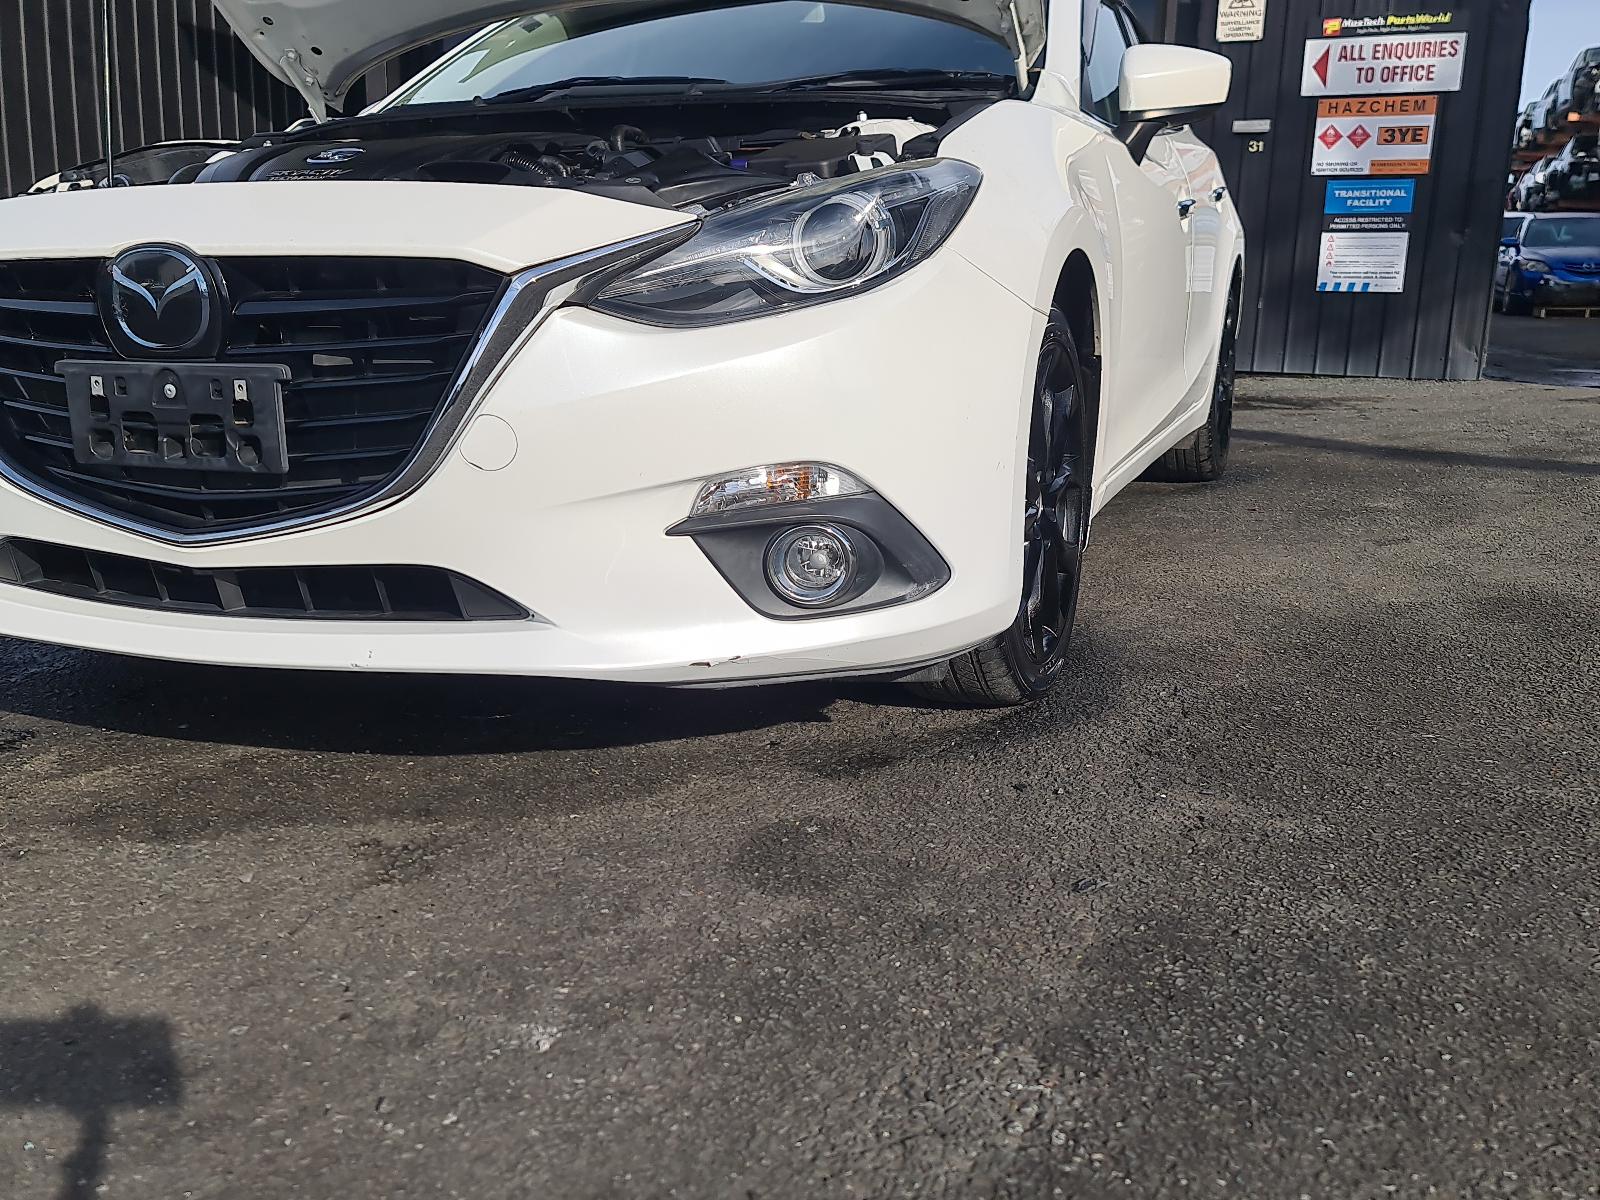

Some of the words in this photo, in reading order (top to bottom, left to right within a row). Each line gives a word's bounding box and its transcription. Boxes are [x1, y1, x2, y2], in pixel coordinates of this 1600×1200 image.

[1220, 10, 1262, 18] WARNING
[1337, 43, 1366, 62] ALL
[1372, 40, 1459, 60] ENQUIRIES
[1356, 66, 1375, 84] TO
[1381, 64, 1436, 83] OFFICE
[1327, 99, 1426, 114] HAZCHEM
[1383, 128, 1424, 143] 3YE
[1248, 140, 1264, 152] 31
[1334, 189, 1408, 197] TRANSITIONAL
[1346, 199, 1392, 207] FACILITY
